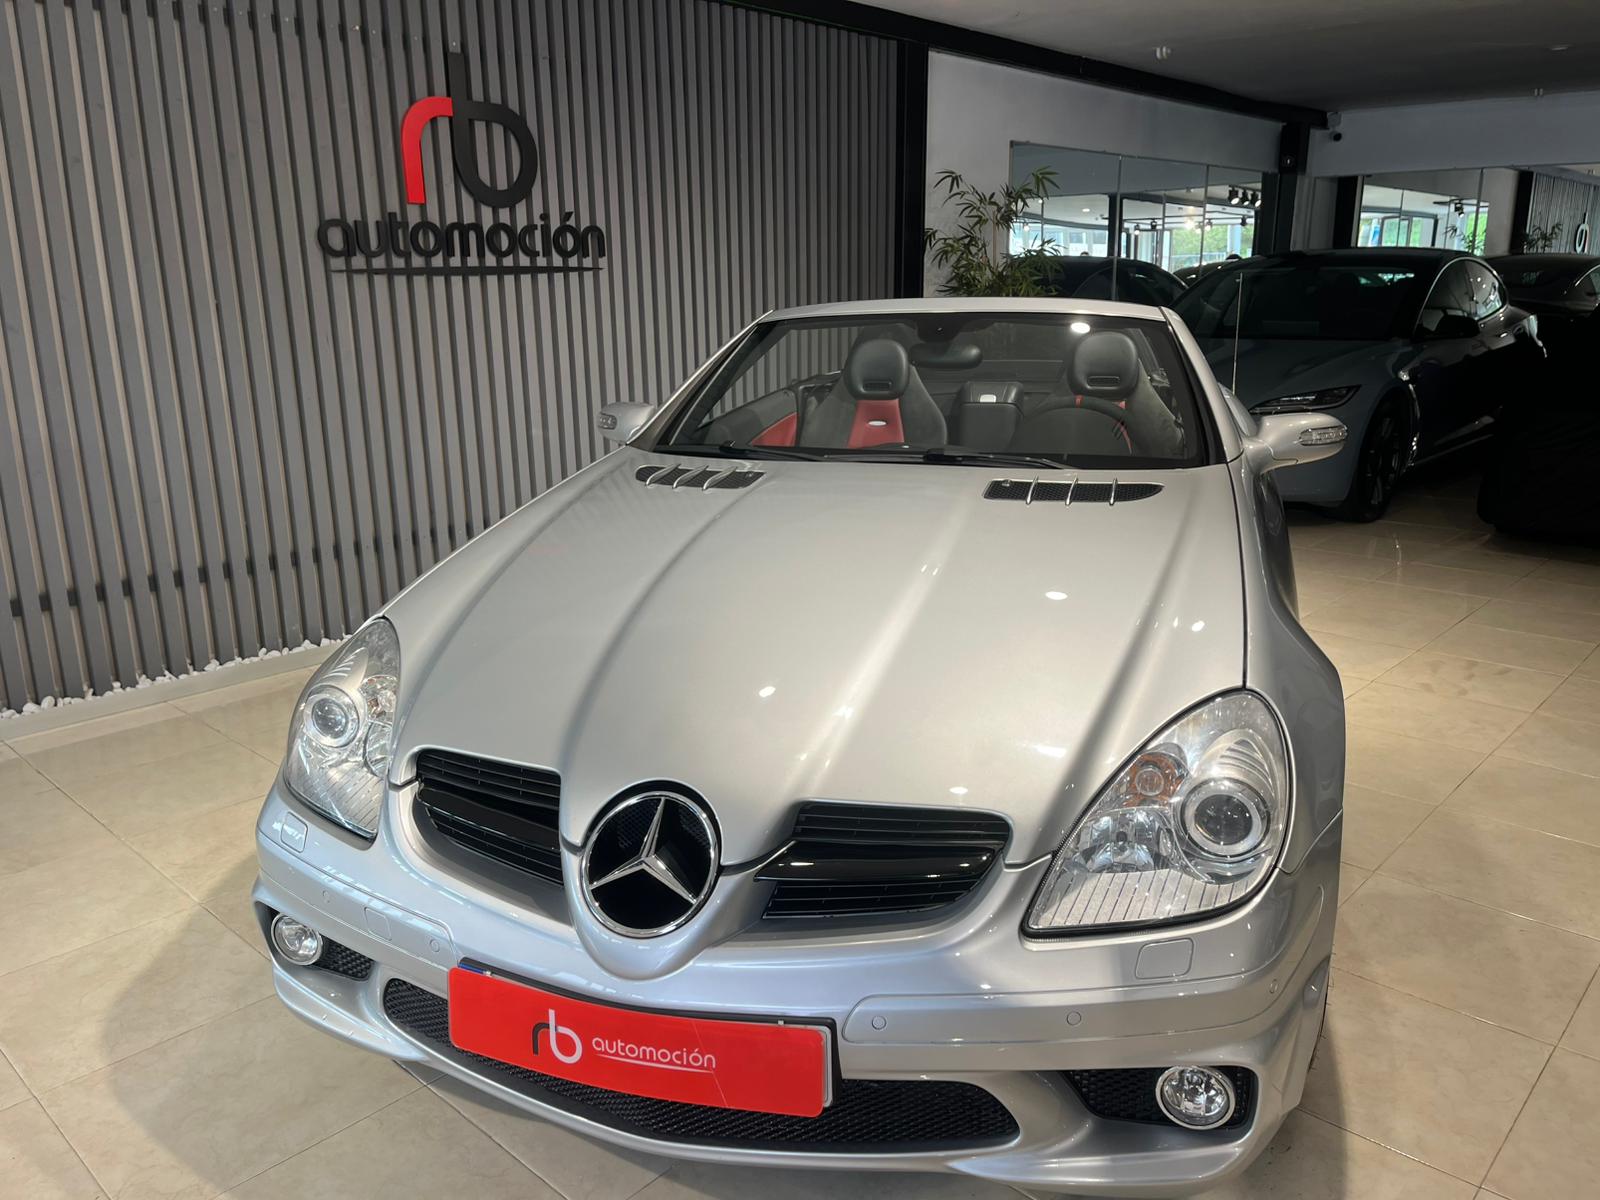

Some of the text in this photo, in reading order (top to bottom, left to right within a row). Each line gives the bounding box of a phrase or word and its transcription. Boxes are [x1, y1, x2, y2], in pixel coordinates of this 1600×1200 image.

[402, 51, 538, 208] rb
[317, 211, 606, 258] automoción
[532, 1008, 716, 1069] rb automoción
